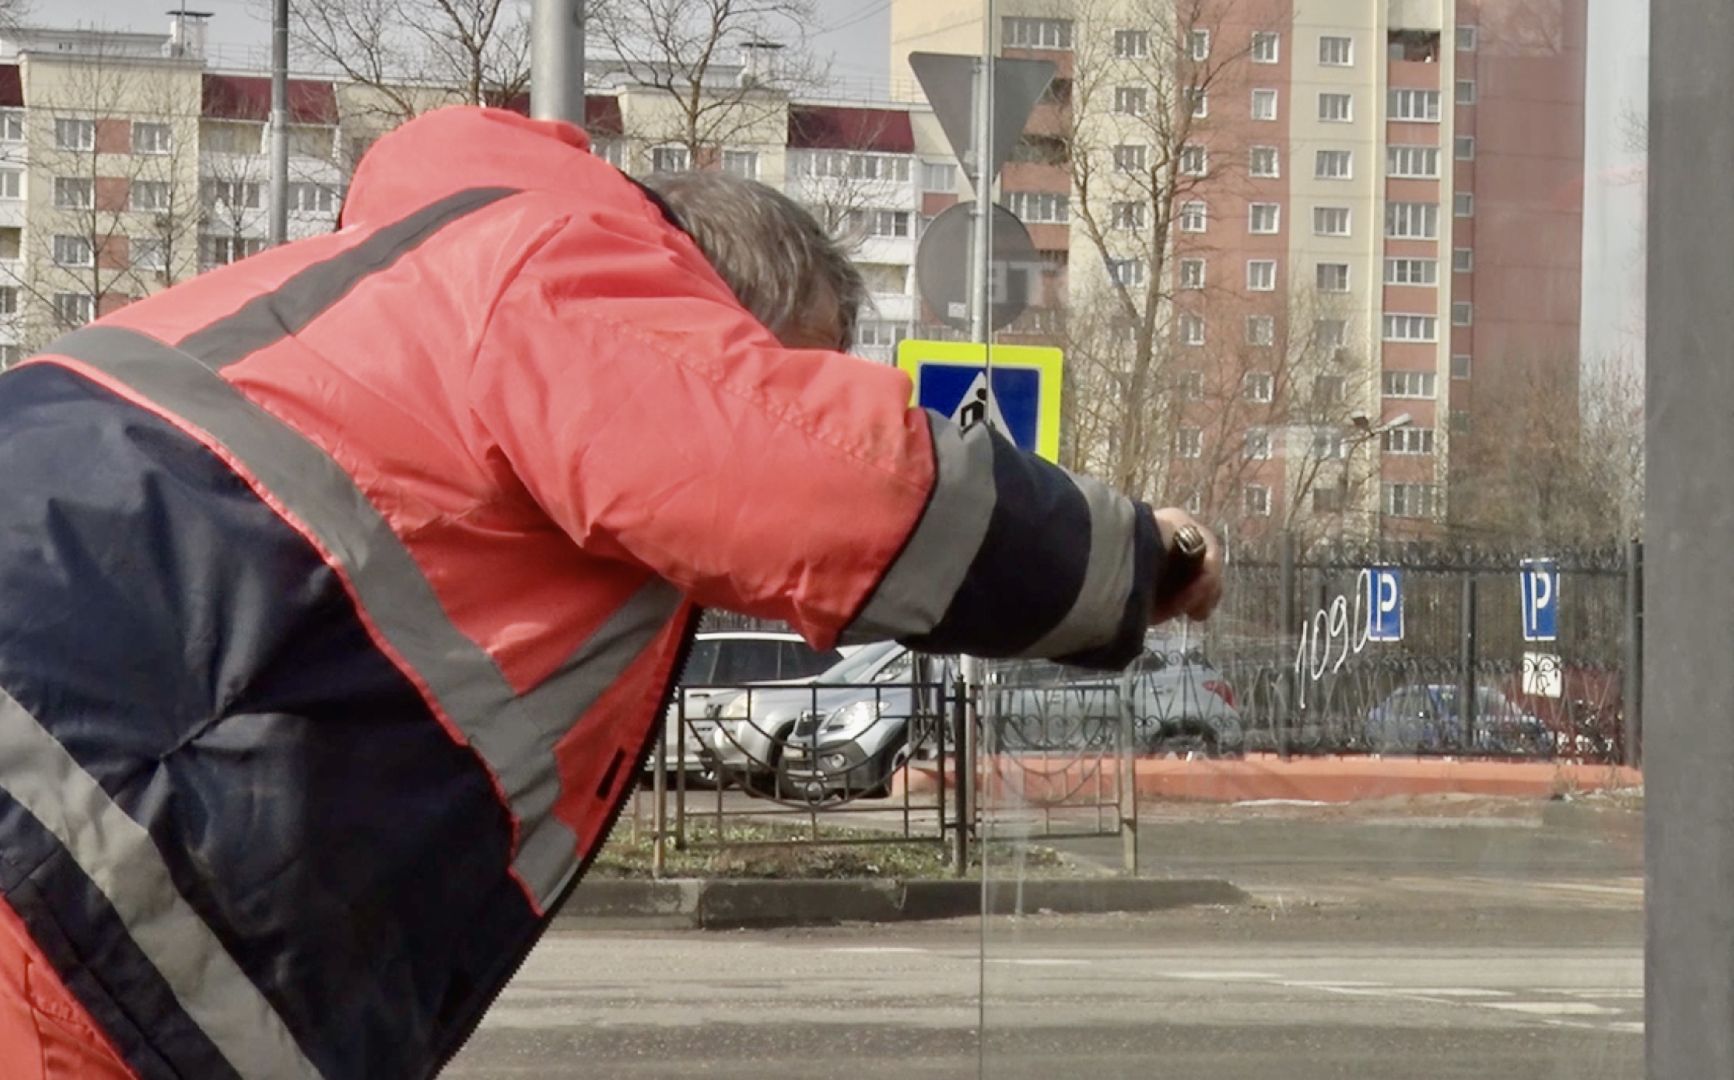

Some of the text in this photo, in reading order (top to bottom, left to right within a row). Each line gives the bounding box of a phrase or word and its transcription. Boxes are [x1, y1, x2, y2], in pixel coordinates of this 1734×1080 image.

[1376, 573, 1398, 632] P
[1530, 571, 1552, 630] P
[1294, 568, 1371, 709] 1090
